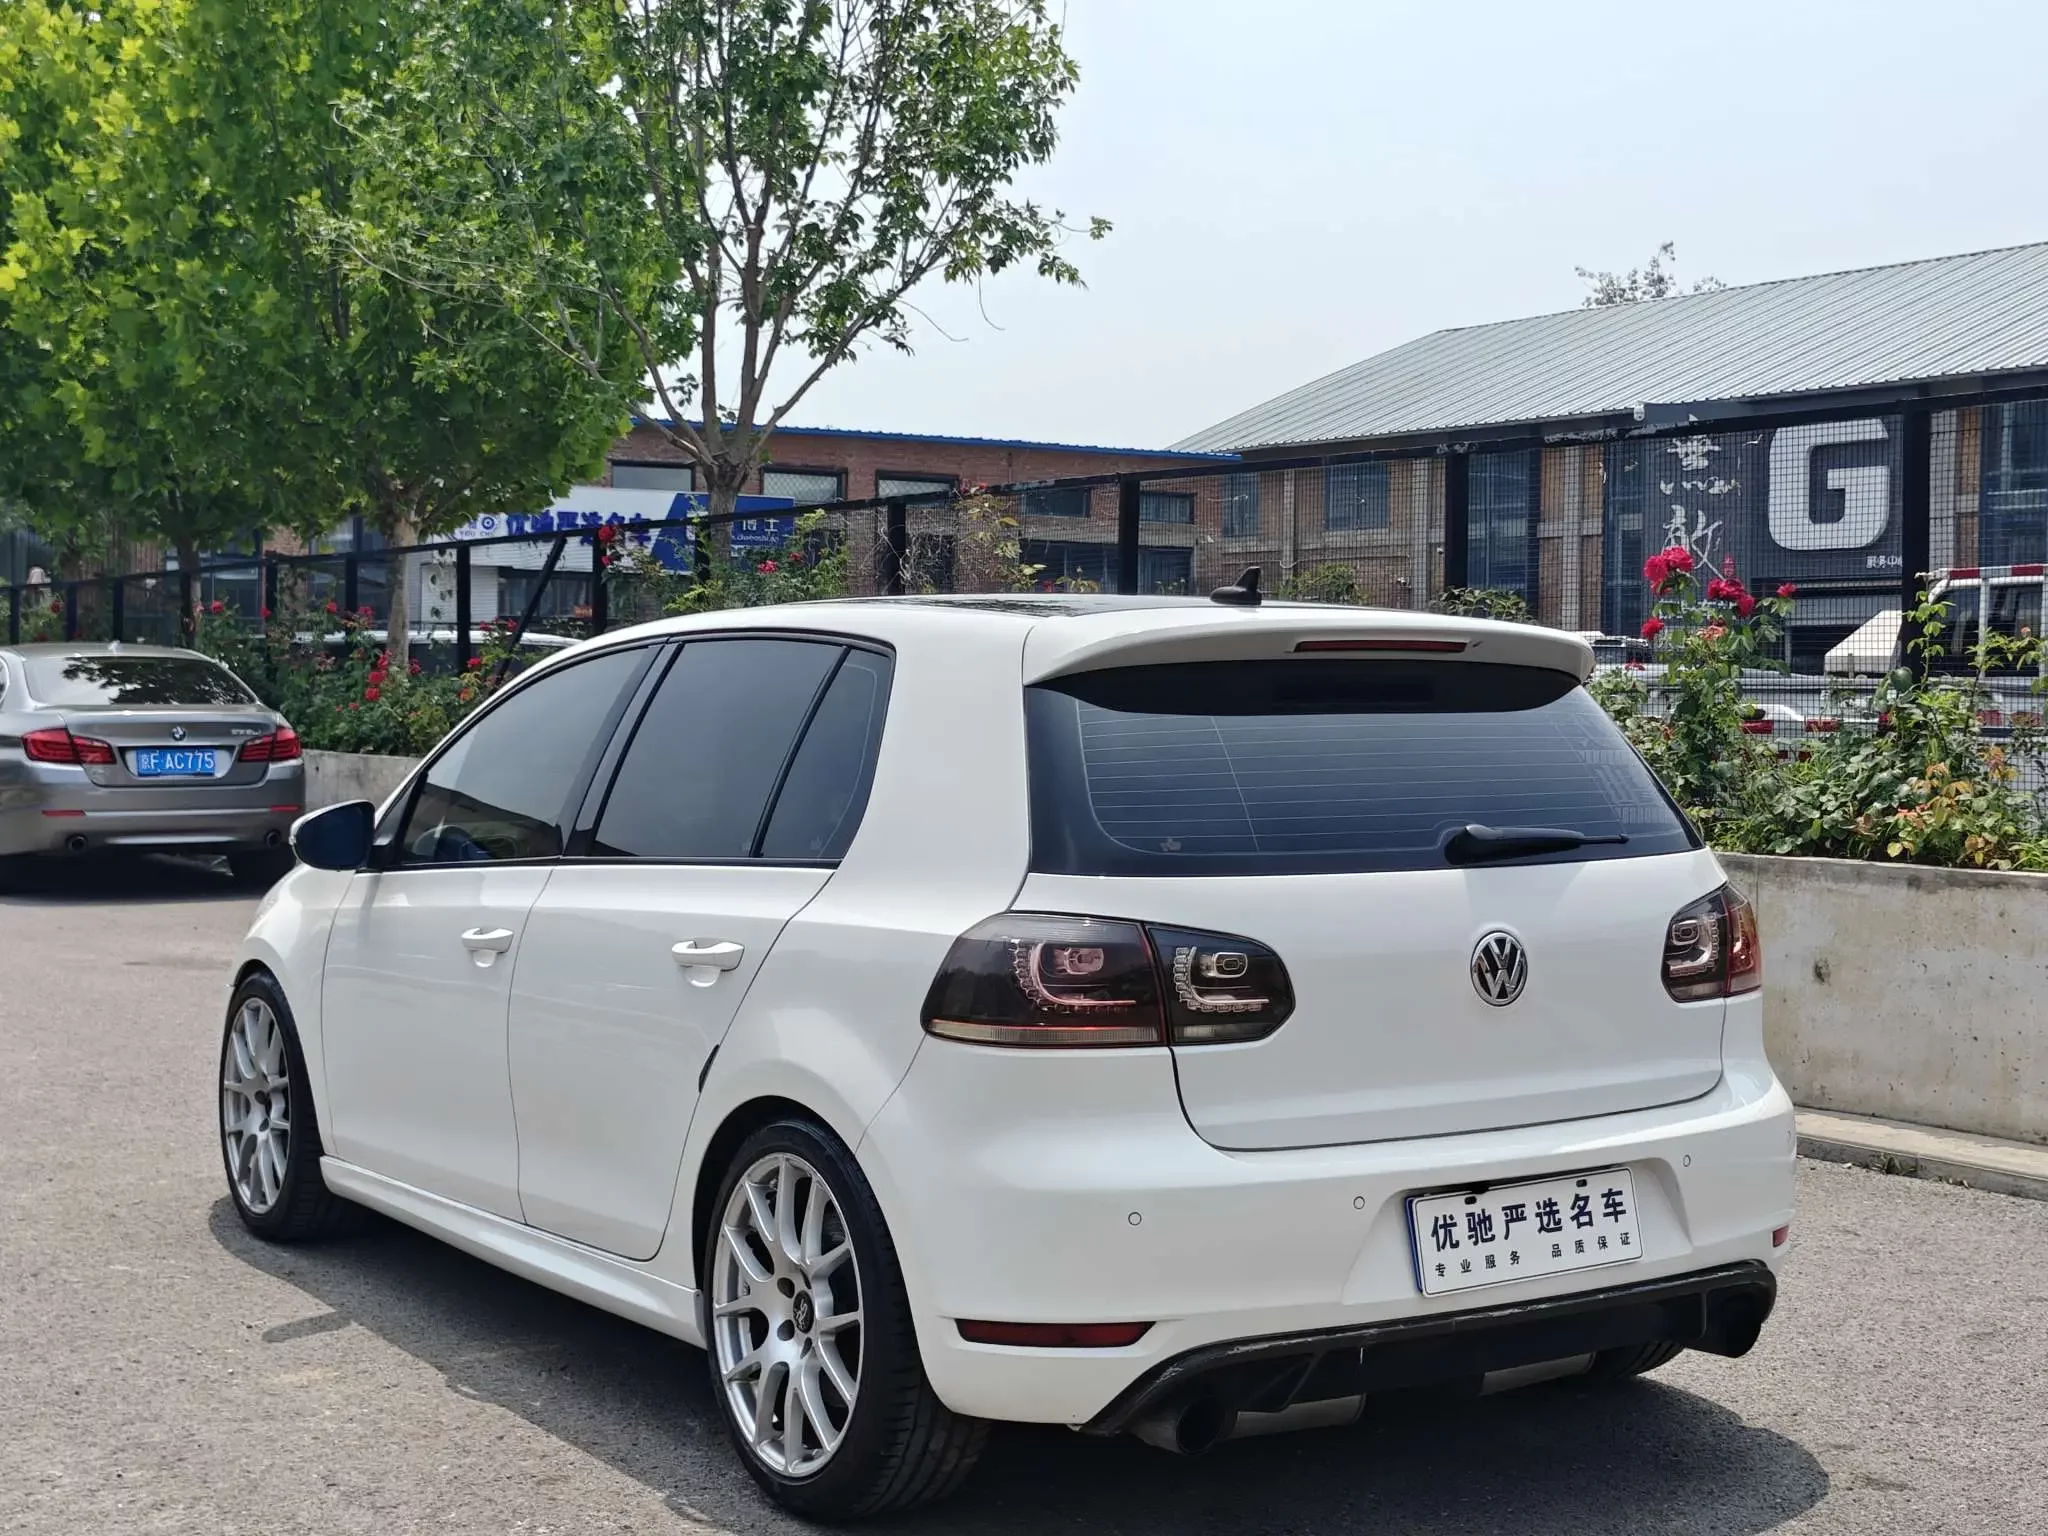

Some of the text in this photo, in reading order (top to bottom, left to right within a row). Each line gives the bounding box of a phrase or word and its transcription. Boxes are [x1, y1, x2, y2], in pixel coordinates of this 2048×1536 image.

[1769, 418, 1890, 551] G
[1430, 1187, 1627, 1252] 优驰严选名车
[1434, 1231, 1632, 1278] 专业服务 品质保证
